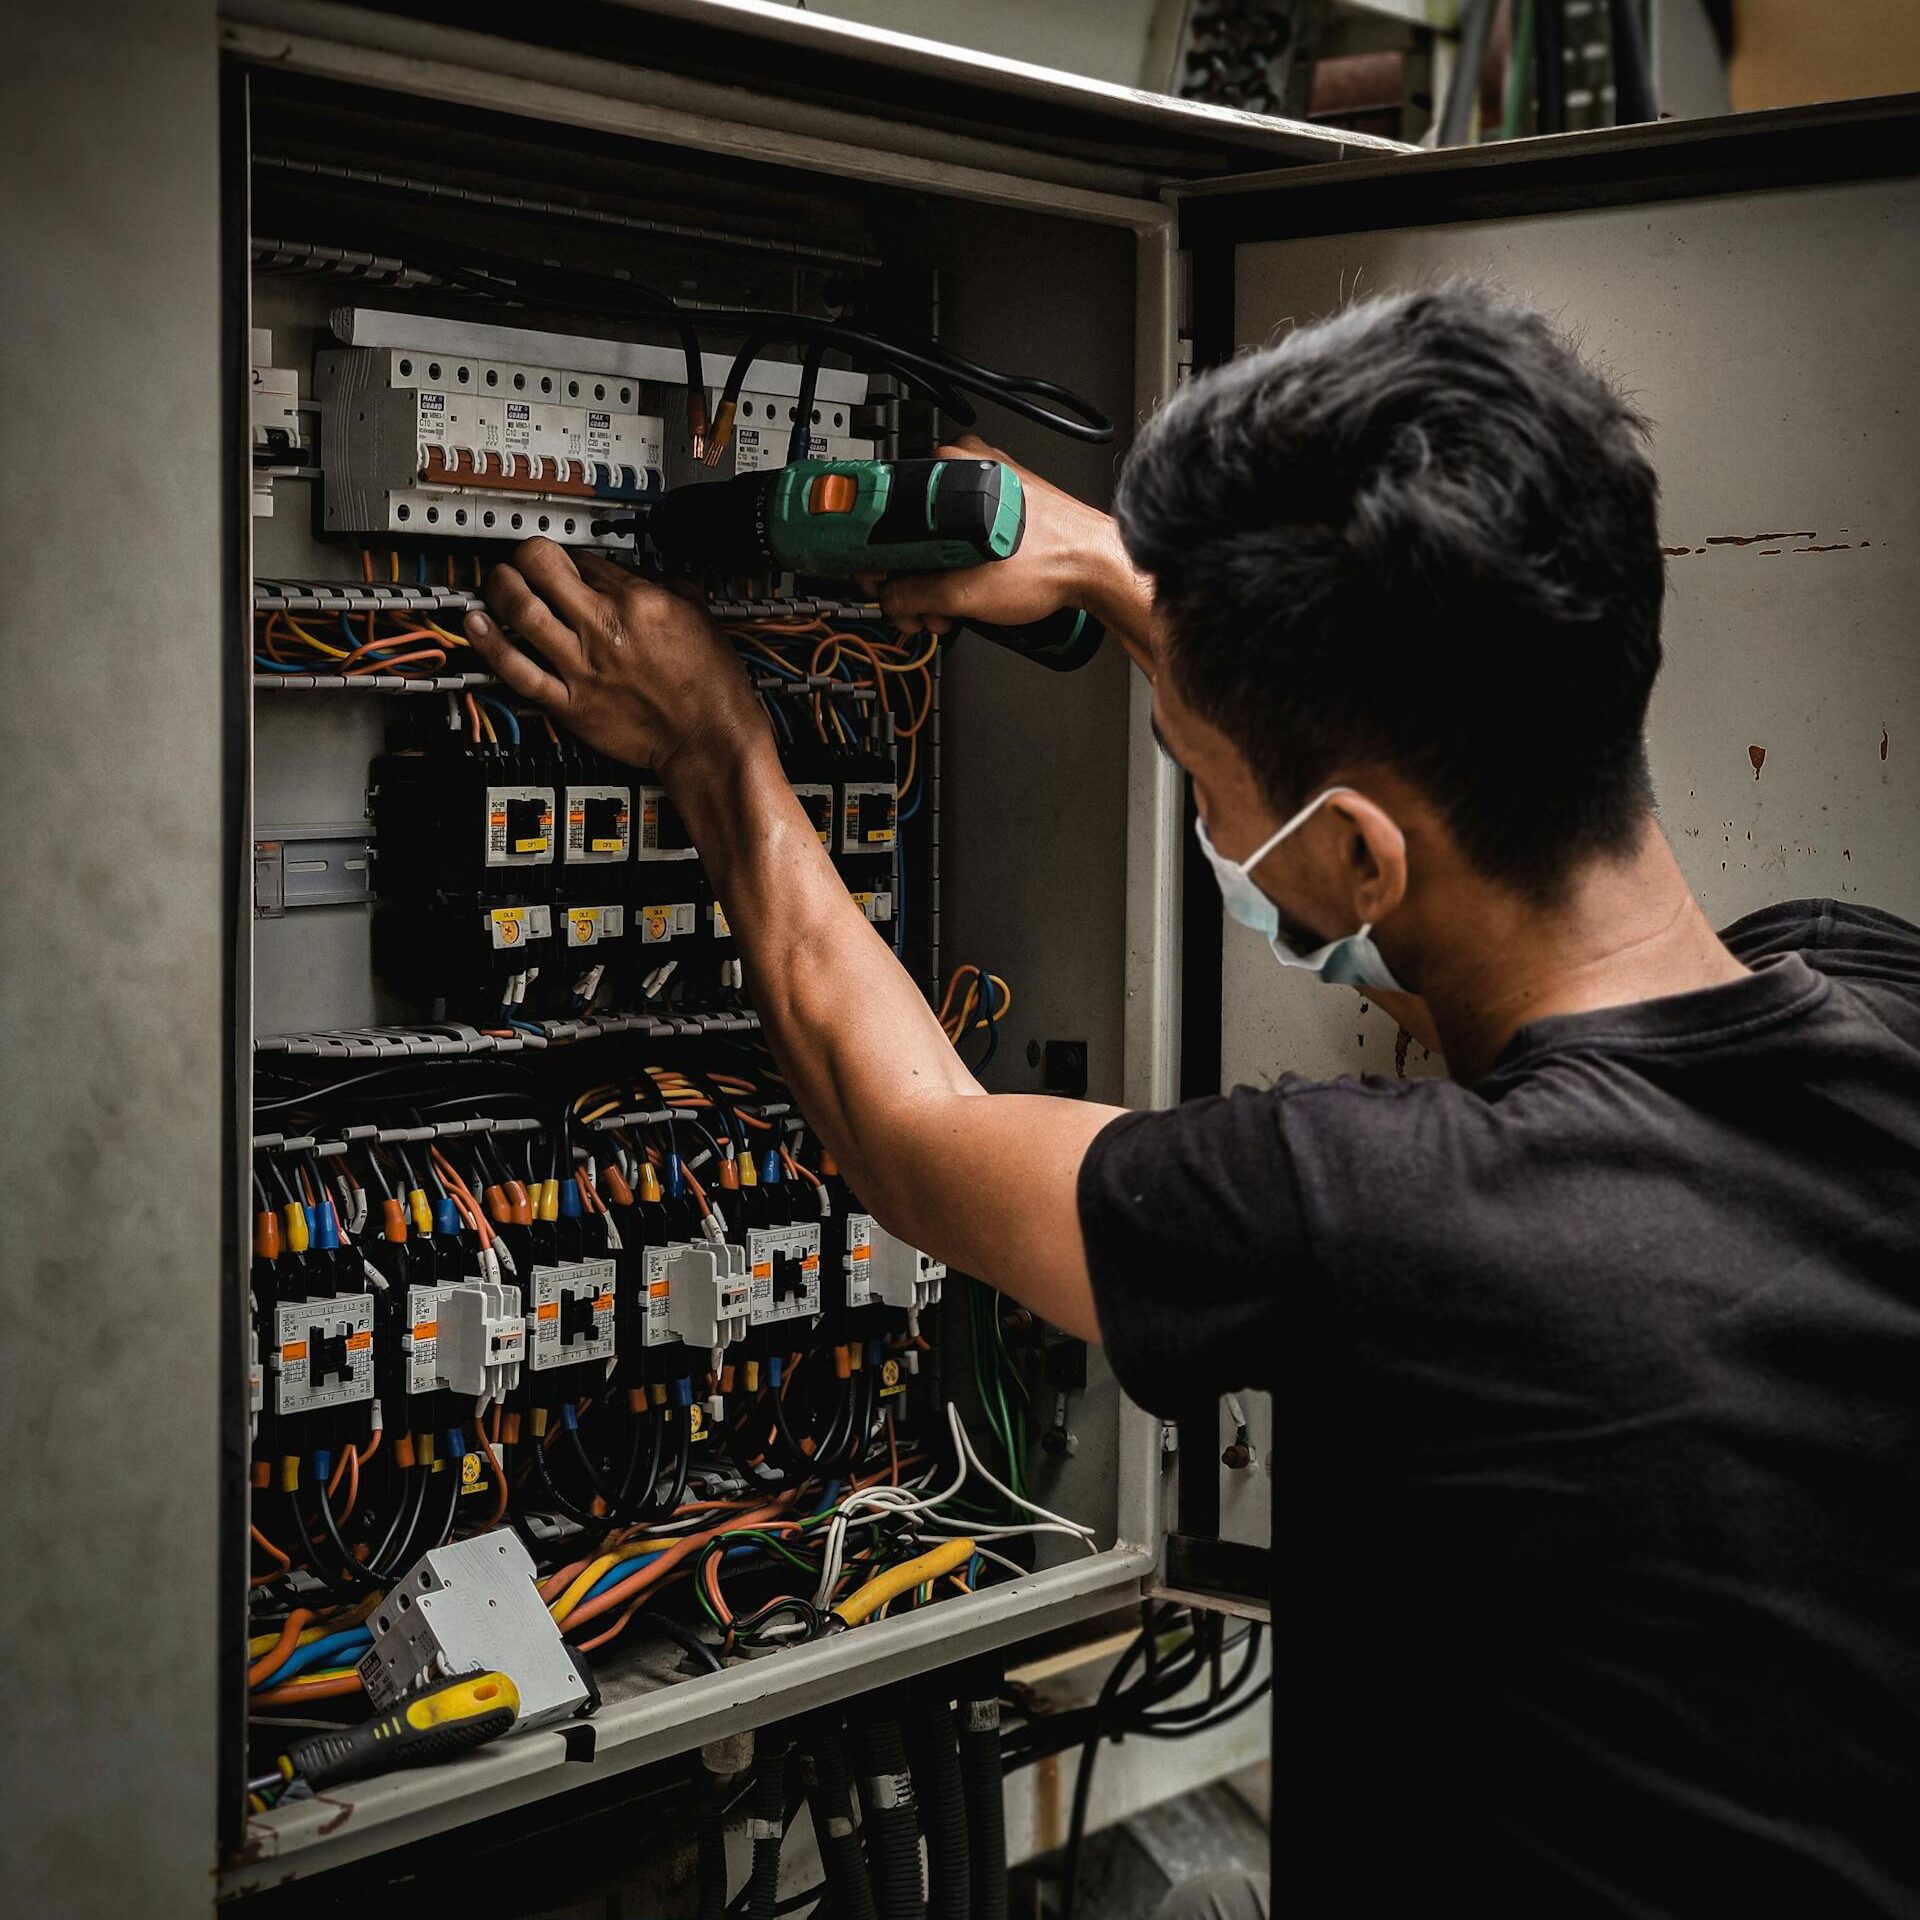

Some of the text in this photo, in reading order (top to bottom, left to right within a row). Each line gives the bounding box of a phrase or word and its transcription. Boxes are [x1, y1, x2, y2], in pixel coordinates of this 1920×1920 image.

[422, 402, 443, 411] GUARD
[508, 411, 529, 420] GUARD
[419, 419, 431, 427] C10
[590, 421, 609, 429] GUARD
